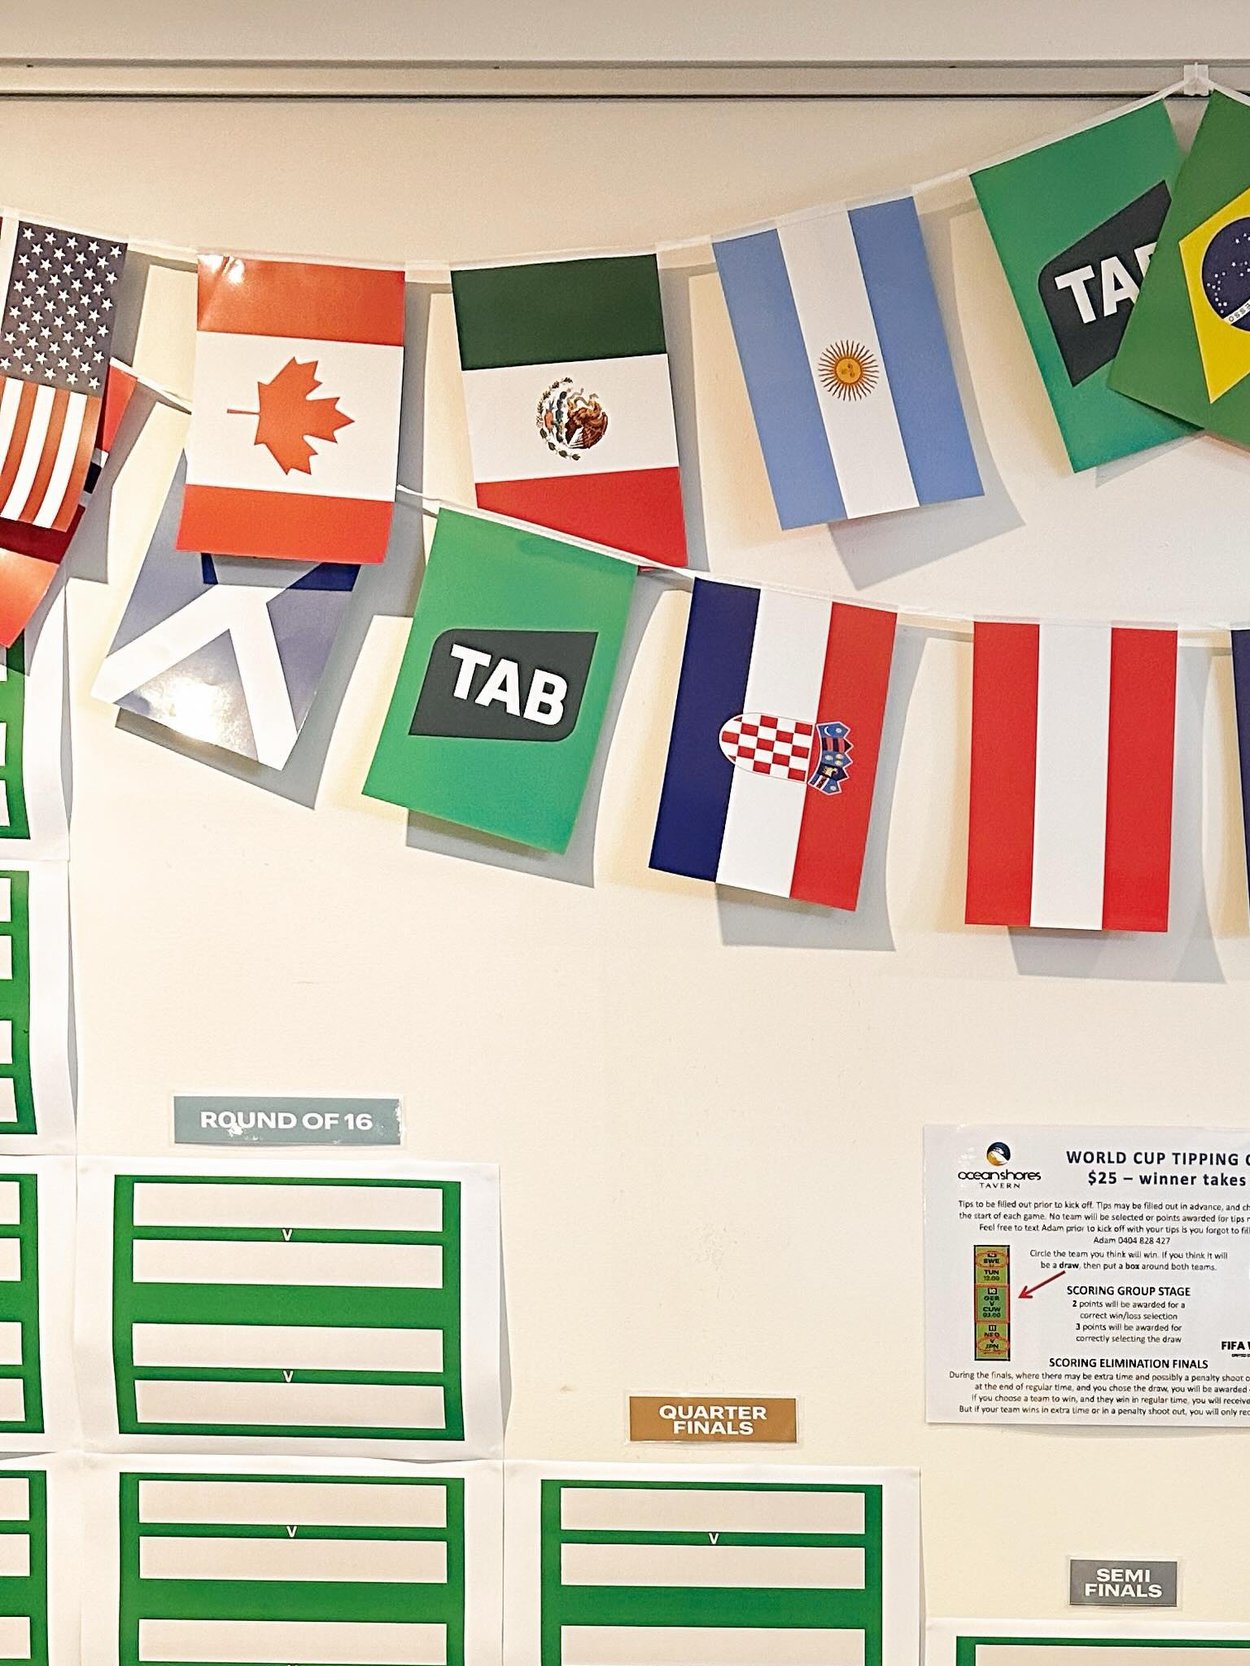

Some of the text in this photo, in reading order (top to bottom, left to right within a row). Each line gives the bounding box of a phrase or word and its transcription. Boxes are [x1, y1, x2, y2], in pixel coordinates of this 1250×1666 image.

[450, 643, 567, 725] TAB
[200, 1111, 373, 1130] ROUND OF 16
[1066, 1150, 1126, 1164] WORLD
[1133, 1151, 1165, 1165] CUP
[1171, 1152, 1238, 1166] TIPPING
[1088, 1169, 1116, 1186] $25
[1138, 1171, 1197, 1185] winner
[1202, 1172, 1246, 1186] takes
[1093, 1236, 1170, 1245] Adam 0404 828 427
[1029, 1249, 1051, 1257] Circle
[1052, 1249, 1066, 1258] the
[1185, 1251, 1205, 1259] think
[1040, 1260, 1050, 1268] be
[1083, 1261, 1101, 1269] then
[1102, 1262, 1116, 1271] put
[1141, 1262, 1169, 1270] around
[1170, 1262, 1189, 1270] both
[1066, 1285, 1190, 1296] SCORING GROUP STAGE
[1072, 1299, 1077, 1308] 2
[1079, 1300, 1103, 1309] points
[1132, 1300, 1165, 1308] awarded
[1109, 1311, 1141, 1320] win/loss
[1075, 1322, 1080, 1330] 3
[1082, 1324, 1106, 1332] points
[1123, 1323, 1134, 1331] be
[1135, 1324, 1168, 1332] awarded
[1075, 1334, 1181, 1344] correctly selecting the draw
[1221, 1340, 1245, 1350] FIFA
[1048, 1357, 1208, 1369] SCORING ELIMINATION FINALS
[659, 1404, 766, 1420] QUARTER
[959, 1404, 972, 1413] But
[1117, 1407, 1146, 1415] penalty
[1148, 1407, 1170, 1415] shoot
[1220, 1408, 1237, 1416] only
[673, 1420, 753, 1435] FINALS
[1096, 1568, 1150, 1582] SEMI
[1084, 1583, 1162, 1598] FINALS
